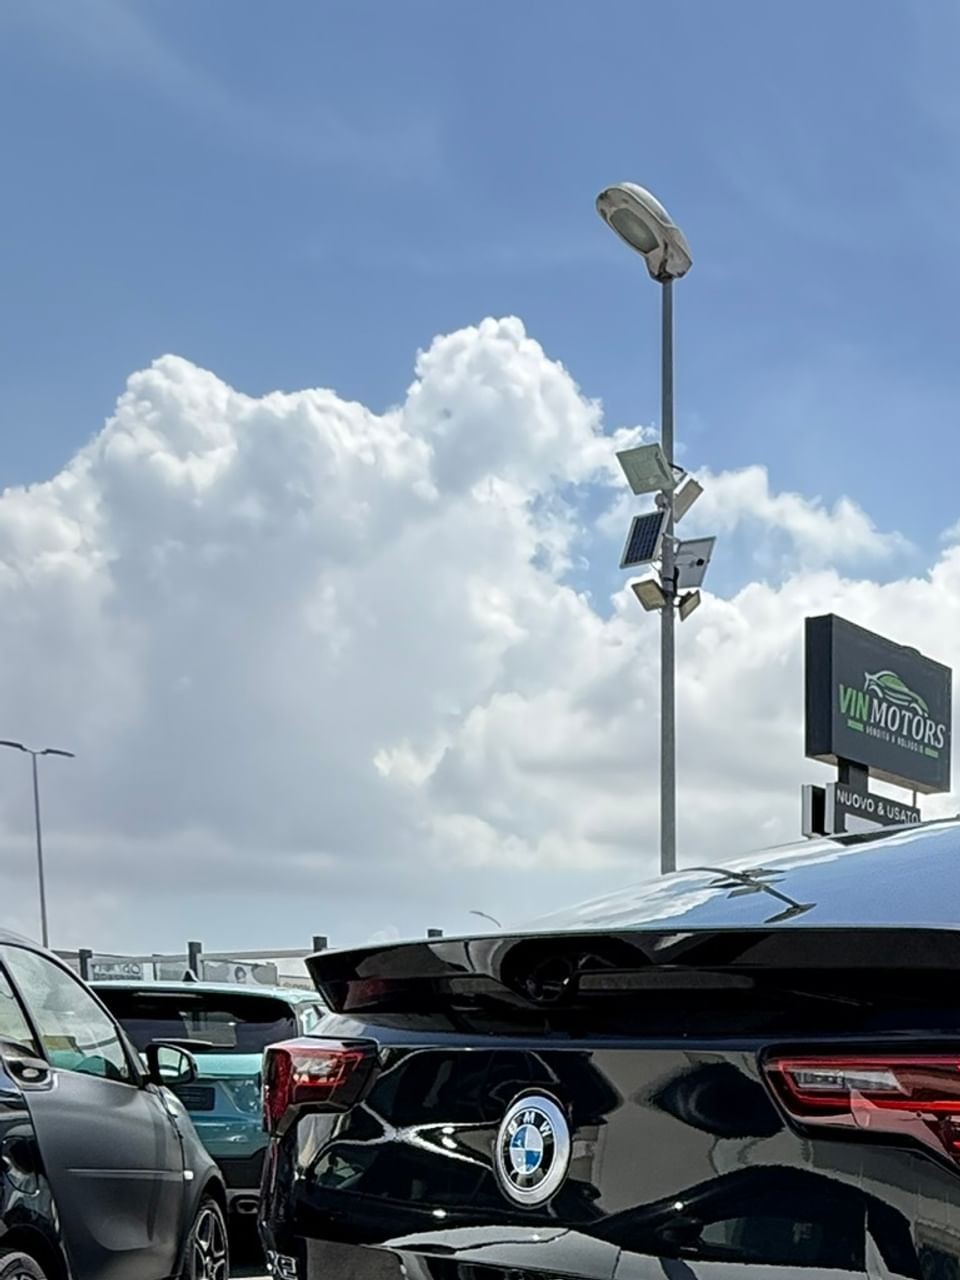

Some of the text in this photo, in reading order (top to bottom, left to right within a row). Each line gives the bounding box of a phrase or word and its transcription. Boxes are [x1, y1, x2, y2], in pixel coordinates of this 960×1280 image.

[839, 683, 870, 722] VIN
[870, 698, 947, 749] MOTORS
[836, 789, 920, 825] NUOVO & USATO
[507, 1110, 553, 1137] BMW
